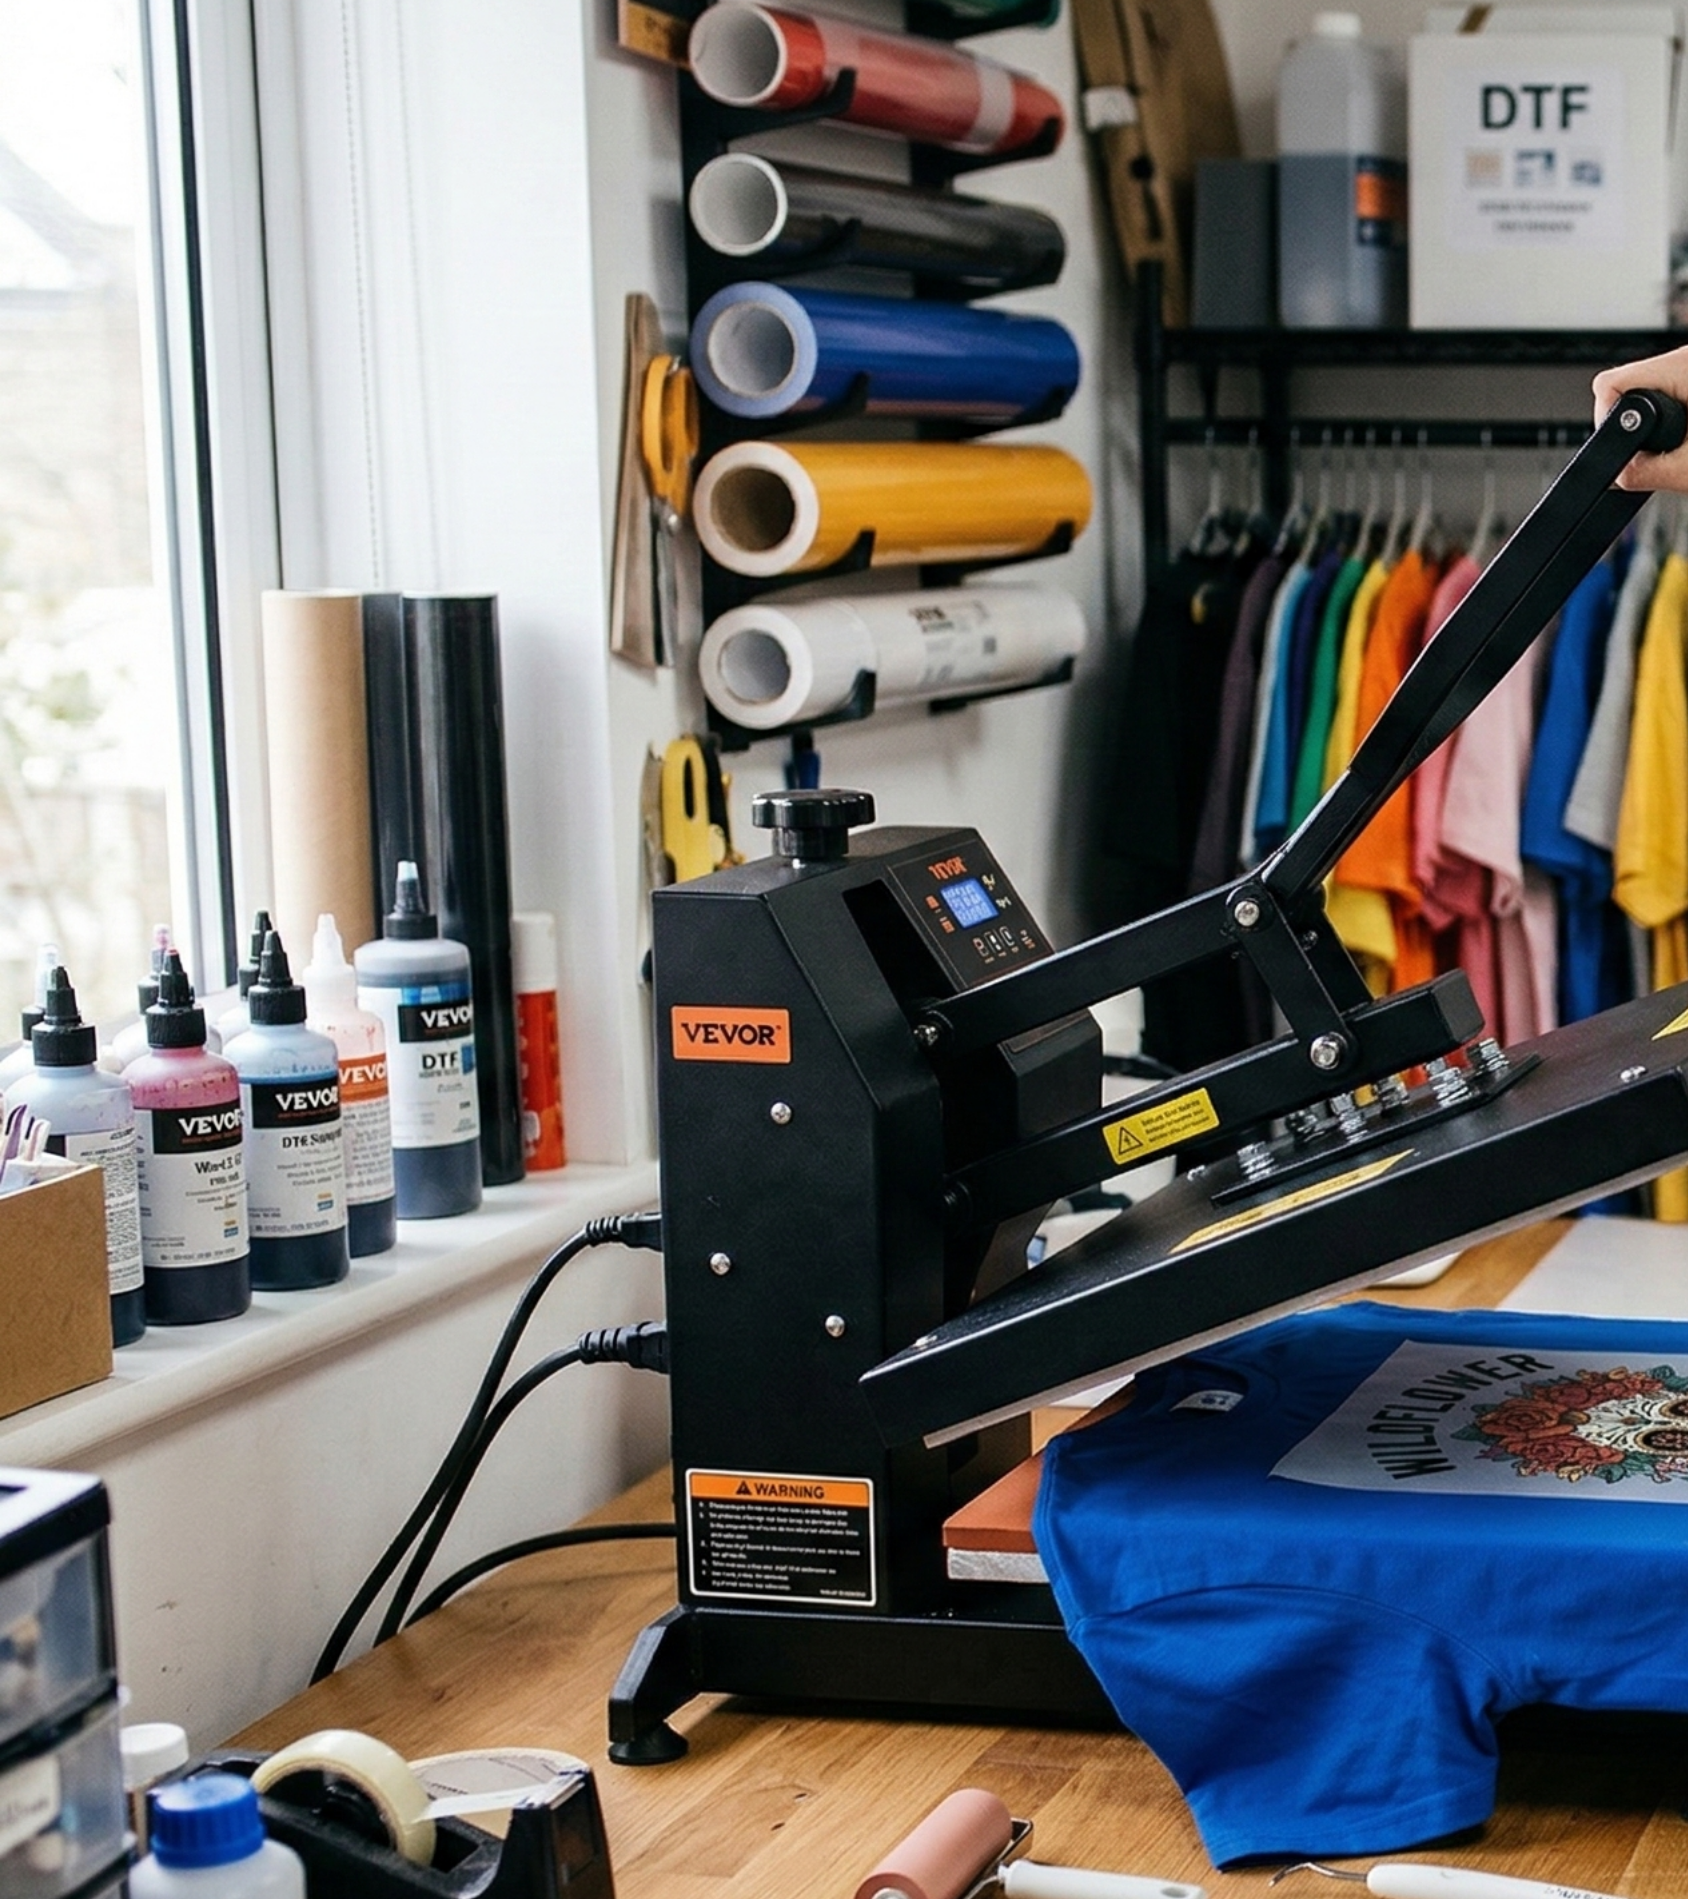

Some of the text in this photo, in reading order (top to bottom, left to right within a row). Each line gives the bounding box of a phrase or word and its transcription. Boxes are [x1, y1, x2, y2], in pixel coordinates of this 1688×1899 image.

[1481, 83, 1590, 130] DTF
[420, 1004, 473, 1028] VEVO
[681, 1023, 777, 1046] VEVOR
[422, 1052, 458, 1070] DTF
[1366, 1353, 1555, 1480] WILDFLOWER
[754, 1482, 825, 1500] WARNING
